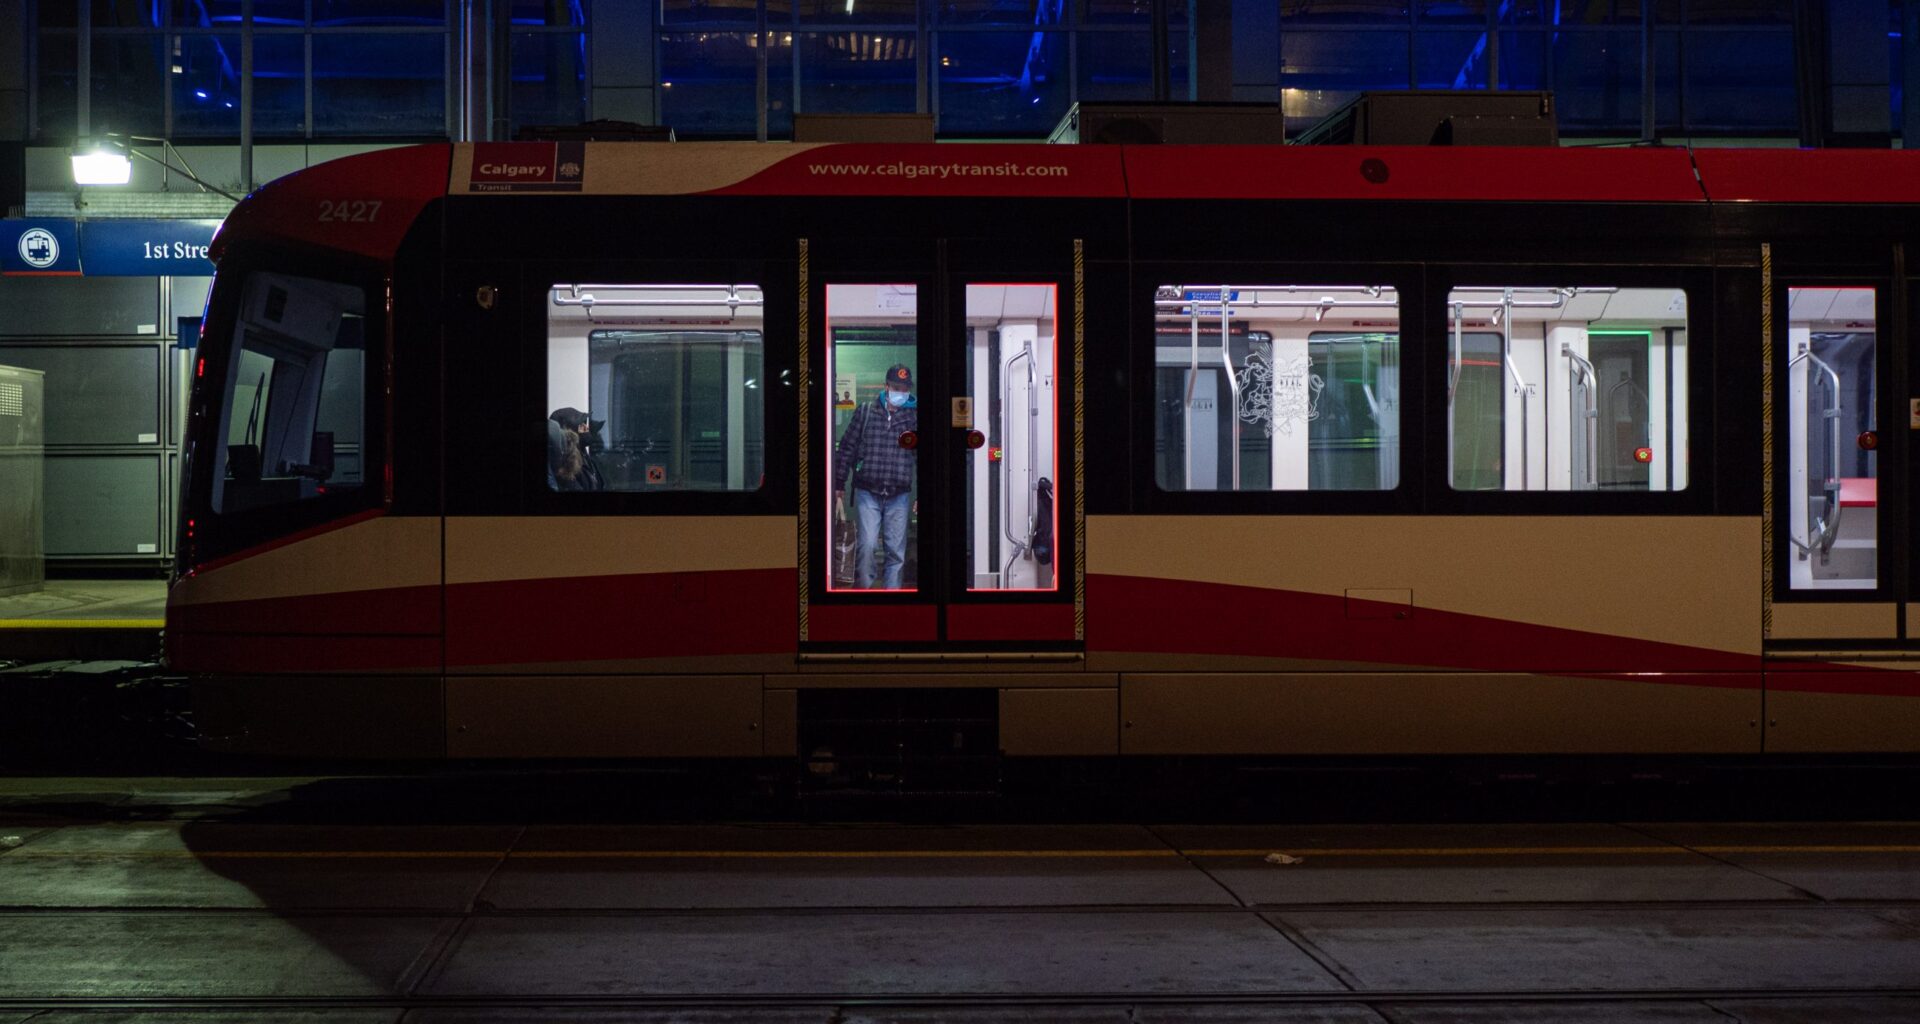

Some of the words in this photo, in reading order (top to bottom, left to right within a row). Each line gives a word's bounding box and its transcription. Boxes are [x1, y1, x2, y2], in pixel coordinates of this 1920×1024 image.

[479, 163, 547, 177] Calgary
[808, 162, 1069, 178] www.calgarytransit.com
[477, 184, 512, 192] Transit
[318, 200, 383, 222] 2427
[143, 241, 170, 259] 1st
[174, 241, 209, 259] Stre
